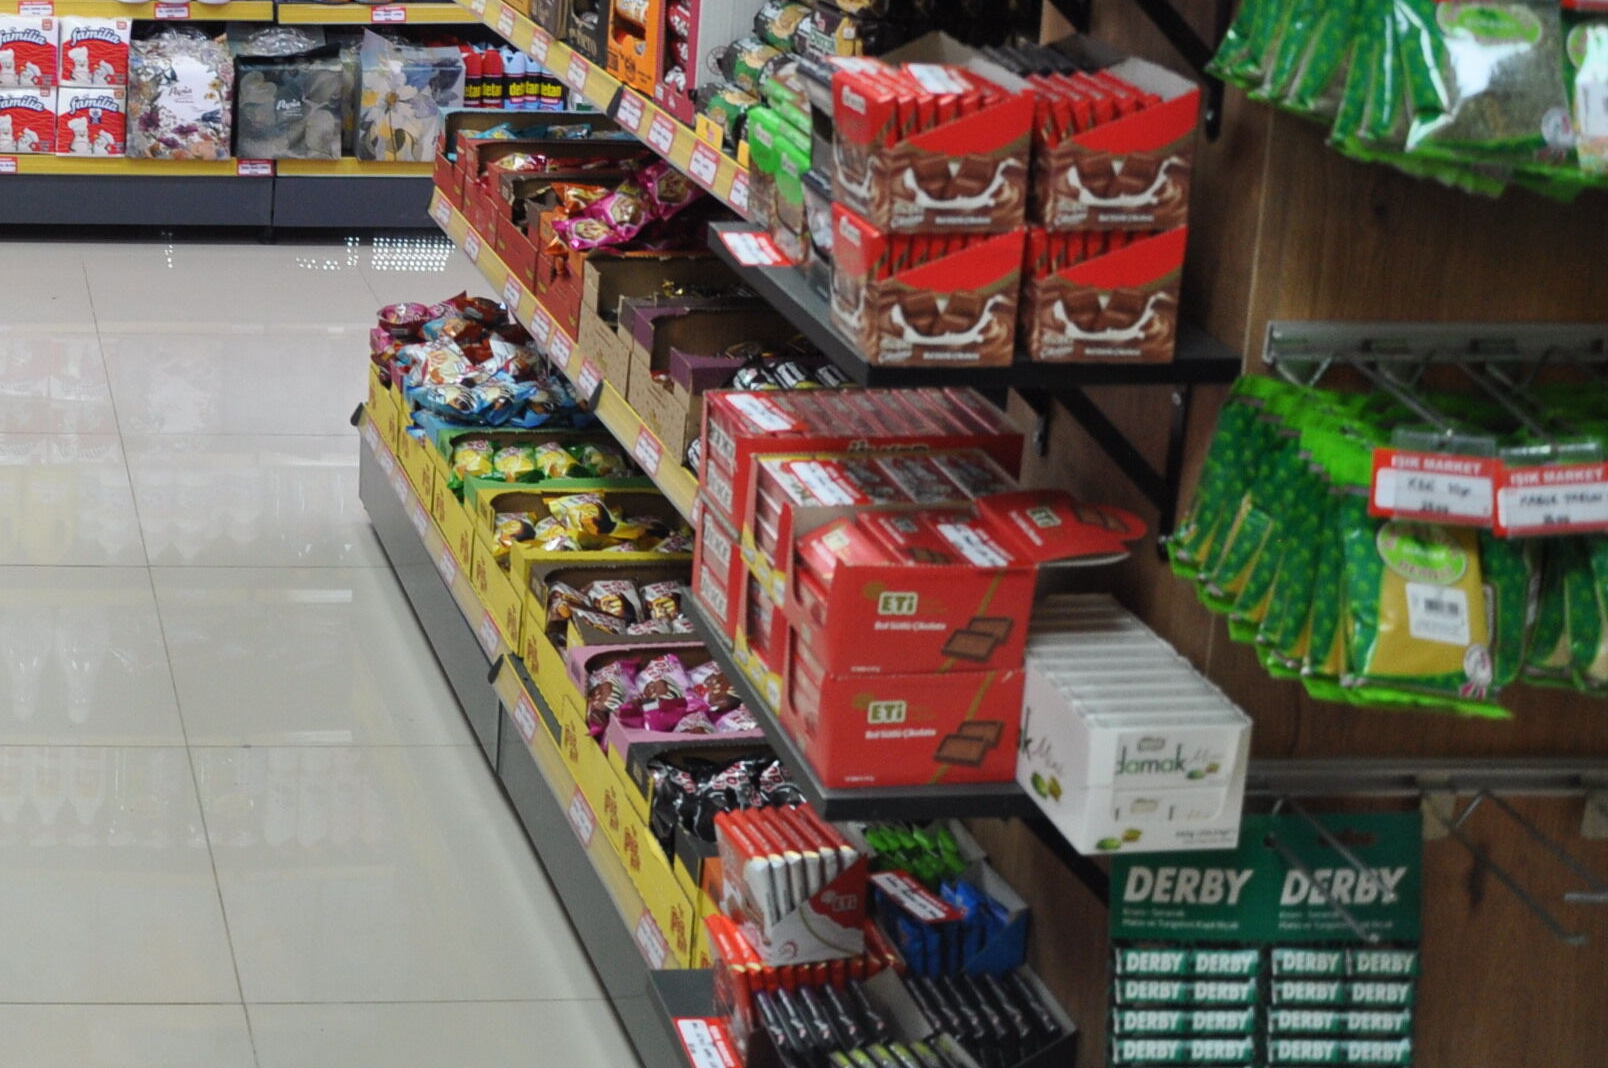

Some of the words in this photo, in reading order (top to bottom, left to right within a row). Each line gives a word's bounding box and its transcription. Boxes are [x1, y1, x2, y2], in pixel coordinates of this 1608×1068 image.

[72, 26, 120, 46] familia
[70, 94, 119, 114] familia
[1424, 458, 1482, 475] MARKET
[1544, 468, 1604, 482] MARKET
[1124, 865, 1253, 906] DERBY
[1281, 866, 1408, 906] DERBY
[1126, 951, 1183, 973] DERBY
[1196, 951, 1253, 974] DERBY
[1283, 951, 1339, 972] DERBY
[1357, 951, 1414, 973] DERBY
[1125, 981, 1180, 1001] DERBY
[1195, 981, 1252, 1001] DERBY
[1282, 981, 1339, 1001] DERBY
[1352, 983, 1408, 1003] DERBY
[1124, 1011, 1180, 1031] DERBY
[1192, 1011, 1251, 1031] DERBY
[1279, 1011, 1336, 1030] DERBY
[1348, 1011, 1406, 1031] DERBY
[1123, 1040, 1179, 1060] DERBY
[1192, 1040, 1250, 1060] DERBY
[1278, 1040, 1335, 1060] DERBY
[1348, 1041, 1405, 1062] DERBY
